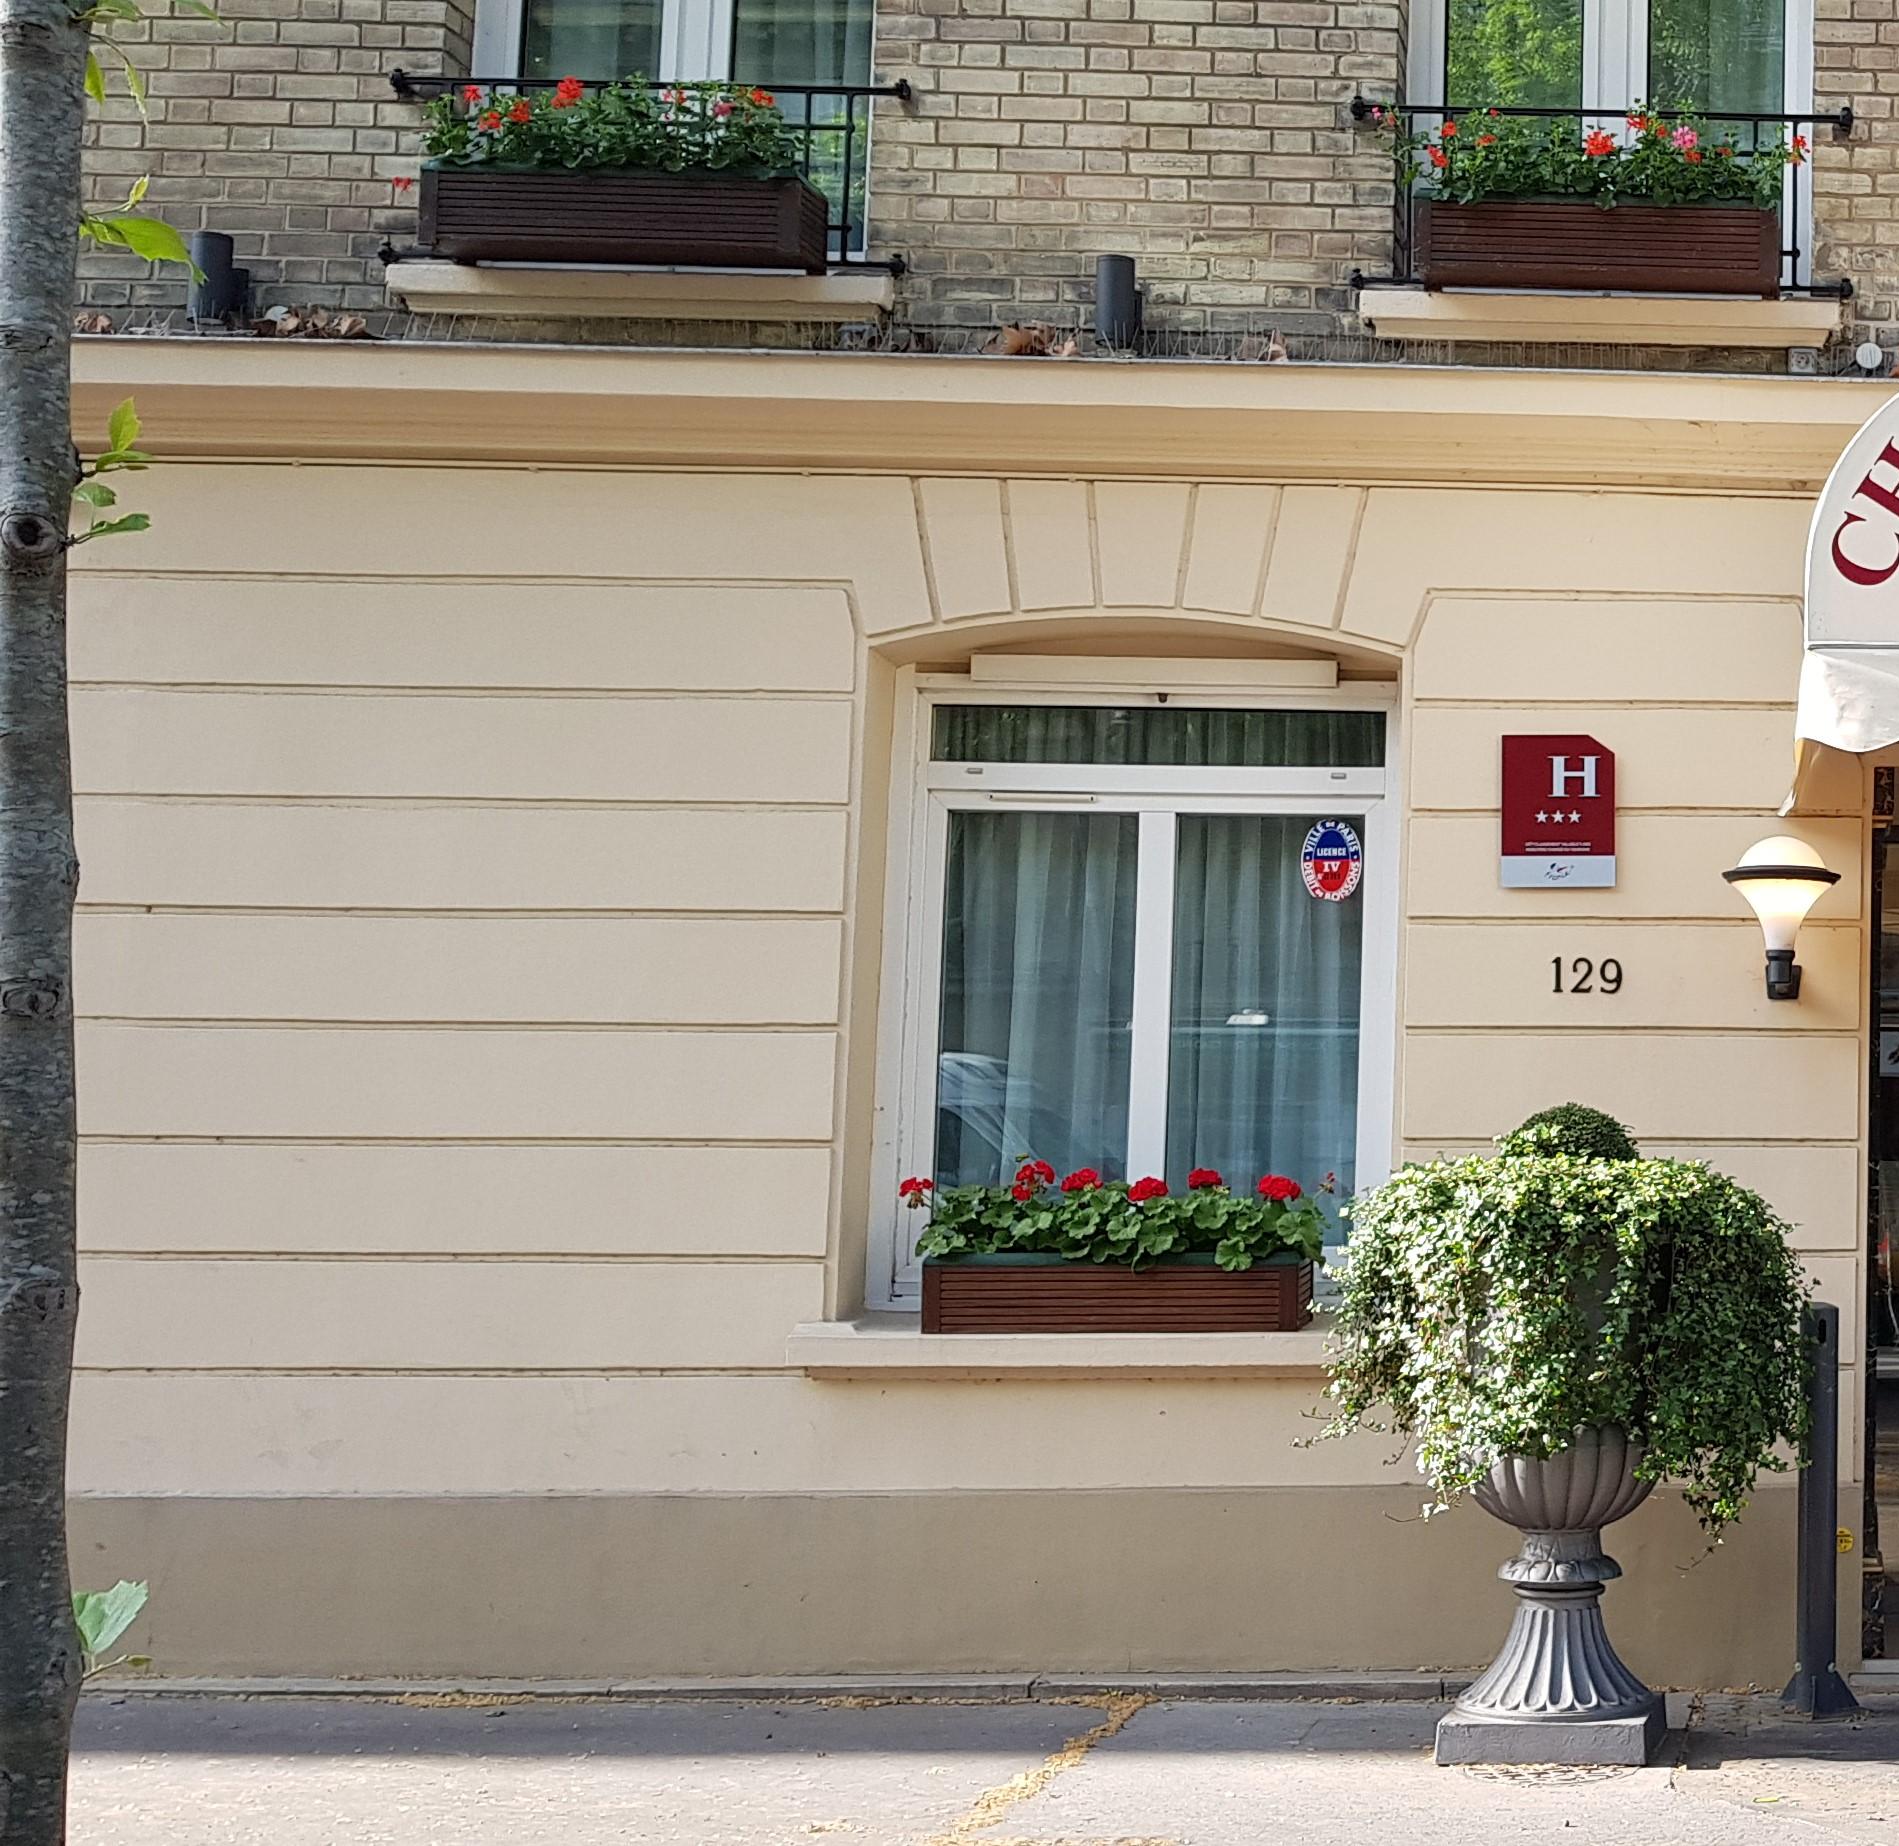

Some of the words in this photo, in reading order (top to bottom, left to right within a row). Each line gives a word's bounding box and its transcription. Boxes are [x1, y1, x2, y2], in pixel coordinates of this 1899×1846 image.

[1547, 755, 1601, 797] H
[1304, 824, 1325, 852] VILLE
[1337, 823, 1359, 852] PARIS
[1316, 847, 1347, 857] LICENCE
[1322, 861, 1341, 872] IV
[1551, 956, 1623, 994] 129
